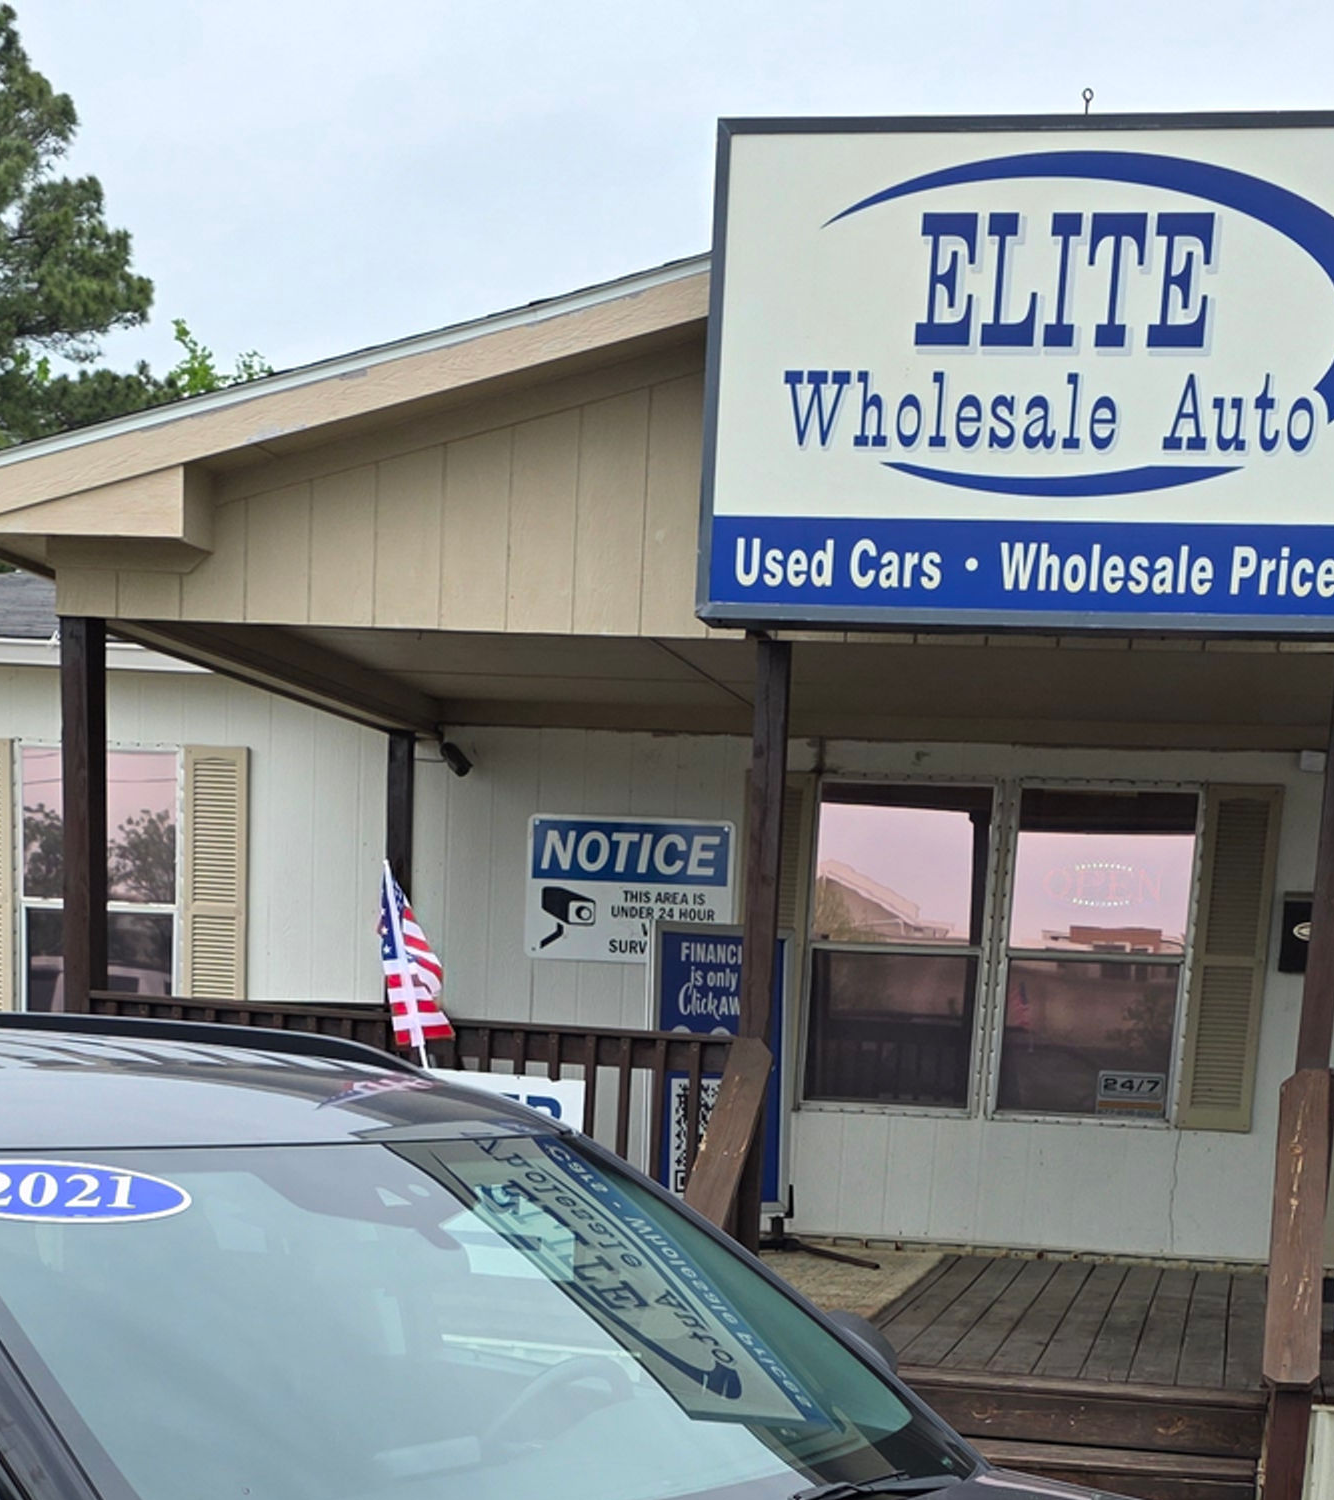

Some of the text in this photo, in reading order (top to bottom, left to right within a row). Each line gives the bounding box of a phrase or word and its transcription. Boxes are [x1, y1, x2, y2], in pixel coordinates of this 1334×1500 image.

[914, 211, 1217, 351] ELITE
[783, 369, 1318, 455] Wholesale Auto
[734, 537, 835, 588] Used
[849, 539, 942, 590] Cars
[1000, 541, 1213, 596] Wholesale
[540, 829, 721, 877] NOTICE
[611, 905, 715, 921] UNDER 24 HOUR
[623, 890, 706, 906] THIS AREA IS
[690, 966, 739, 993] is only
[1103, 1078, 1160, 1092] 24/7
